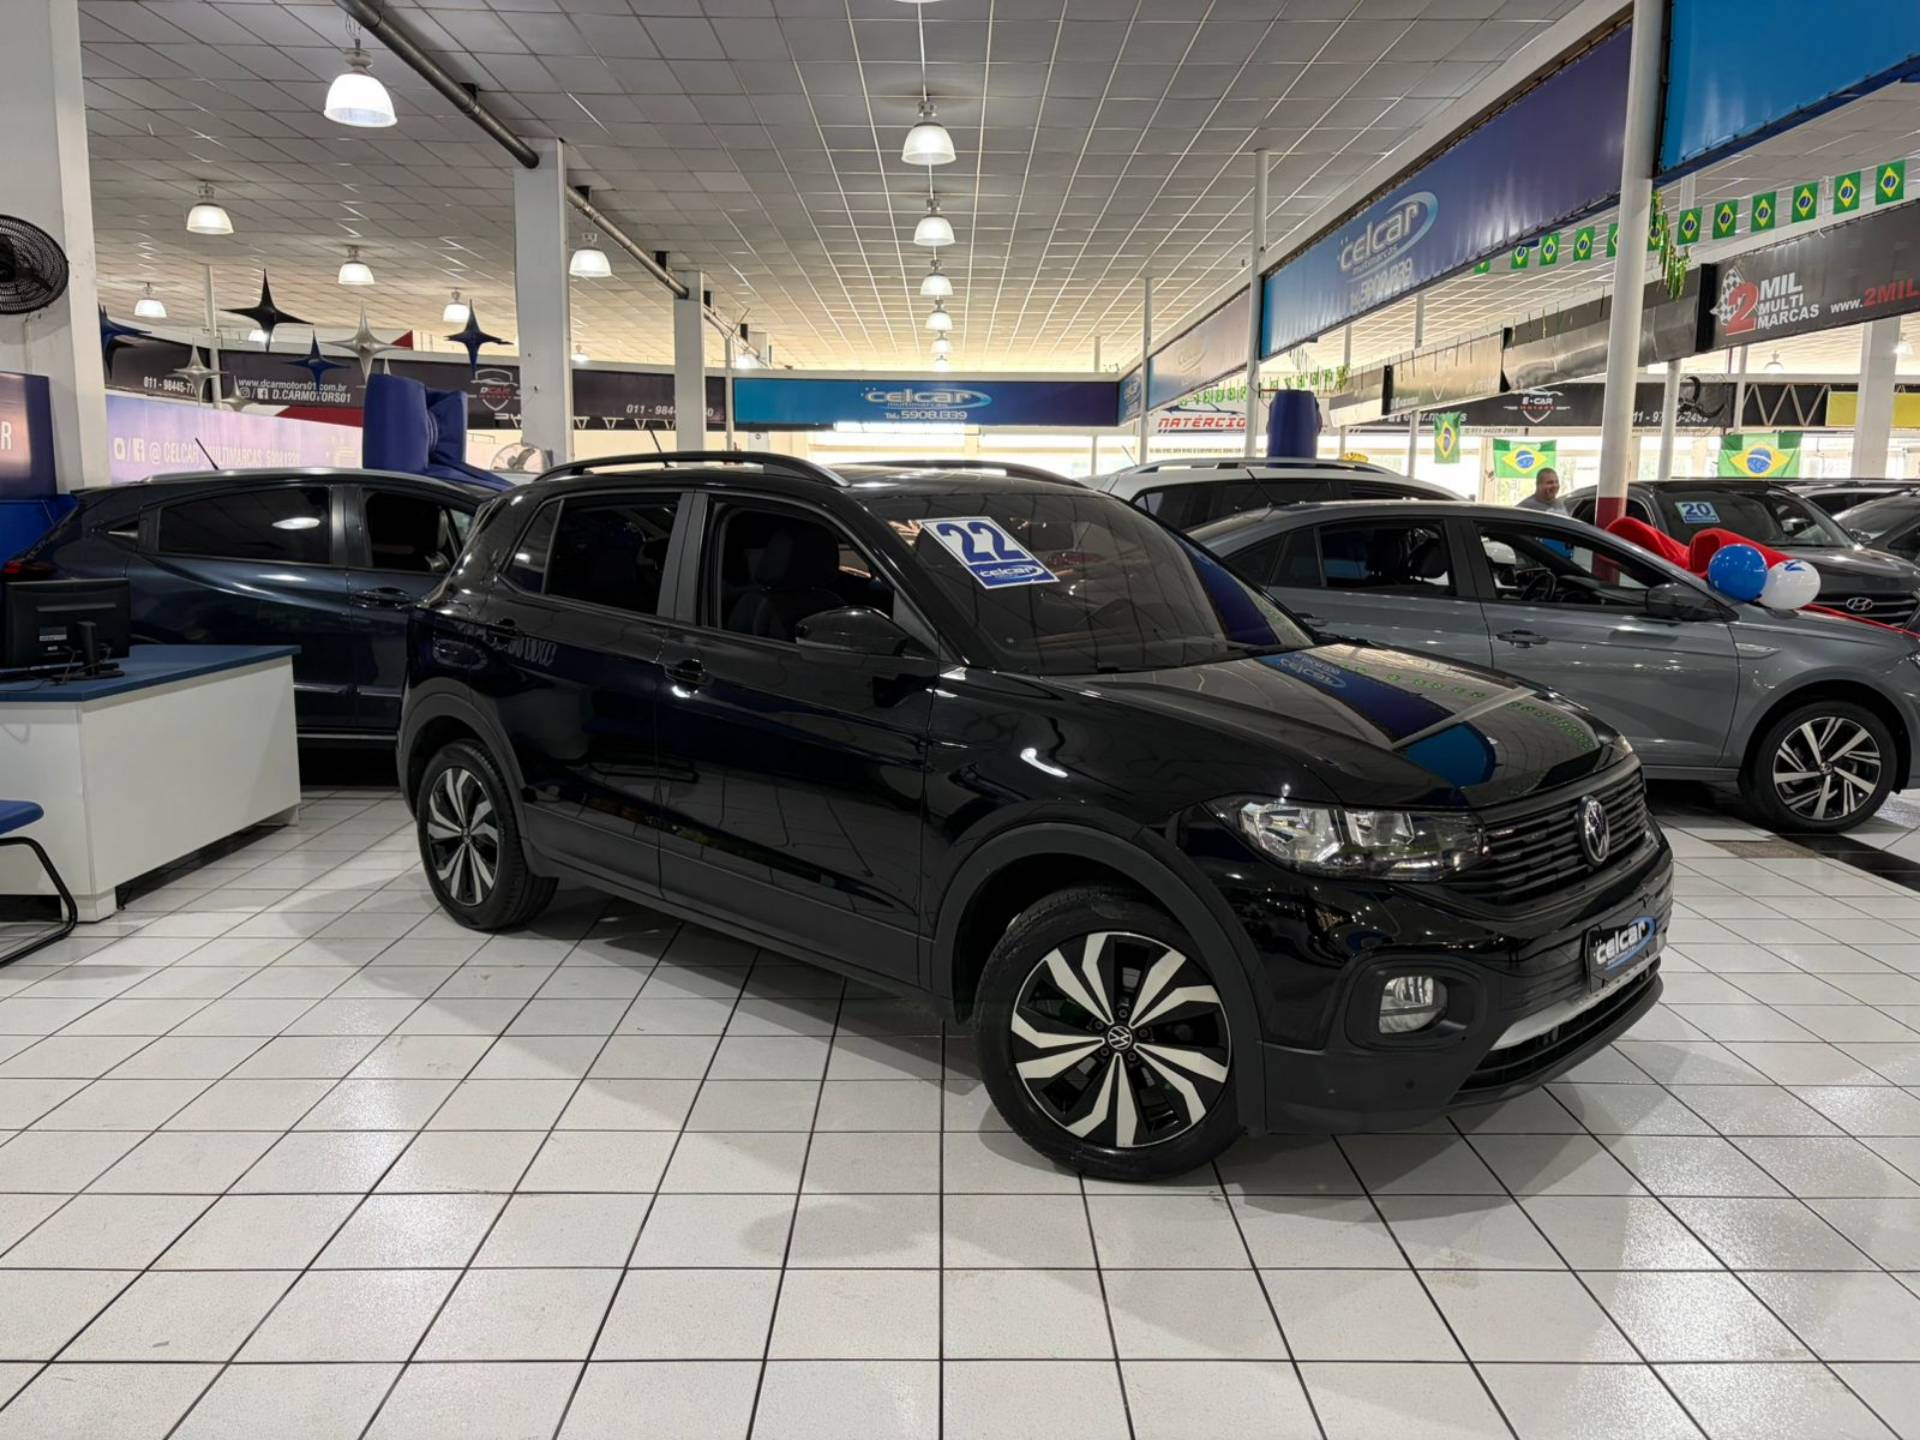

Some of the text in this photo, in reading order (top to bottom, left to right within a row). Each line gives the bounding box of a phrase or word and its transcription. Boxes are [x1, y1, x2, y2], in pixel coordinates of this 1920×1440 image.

[1341, 203, 1419, 272] celcar
[1760, 272, 1803, 301] MIL
[1758, 293, 1804, 316] MULTI
[1757, 304, 1820, 329] MARCAS
[238, 378, 348, 393] www.dcarmotors01com.br
[865, 388, 971, 403] celcar
[626, 403, 645, 414] 011
[1681, 503, 1711, 517] 20
[936, 521, 1028, 563] 22
[980, 565, 1033, 578] celcar
[1596, 920, 1647, 965] celcar
